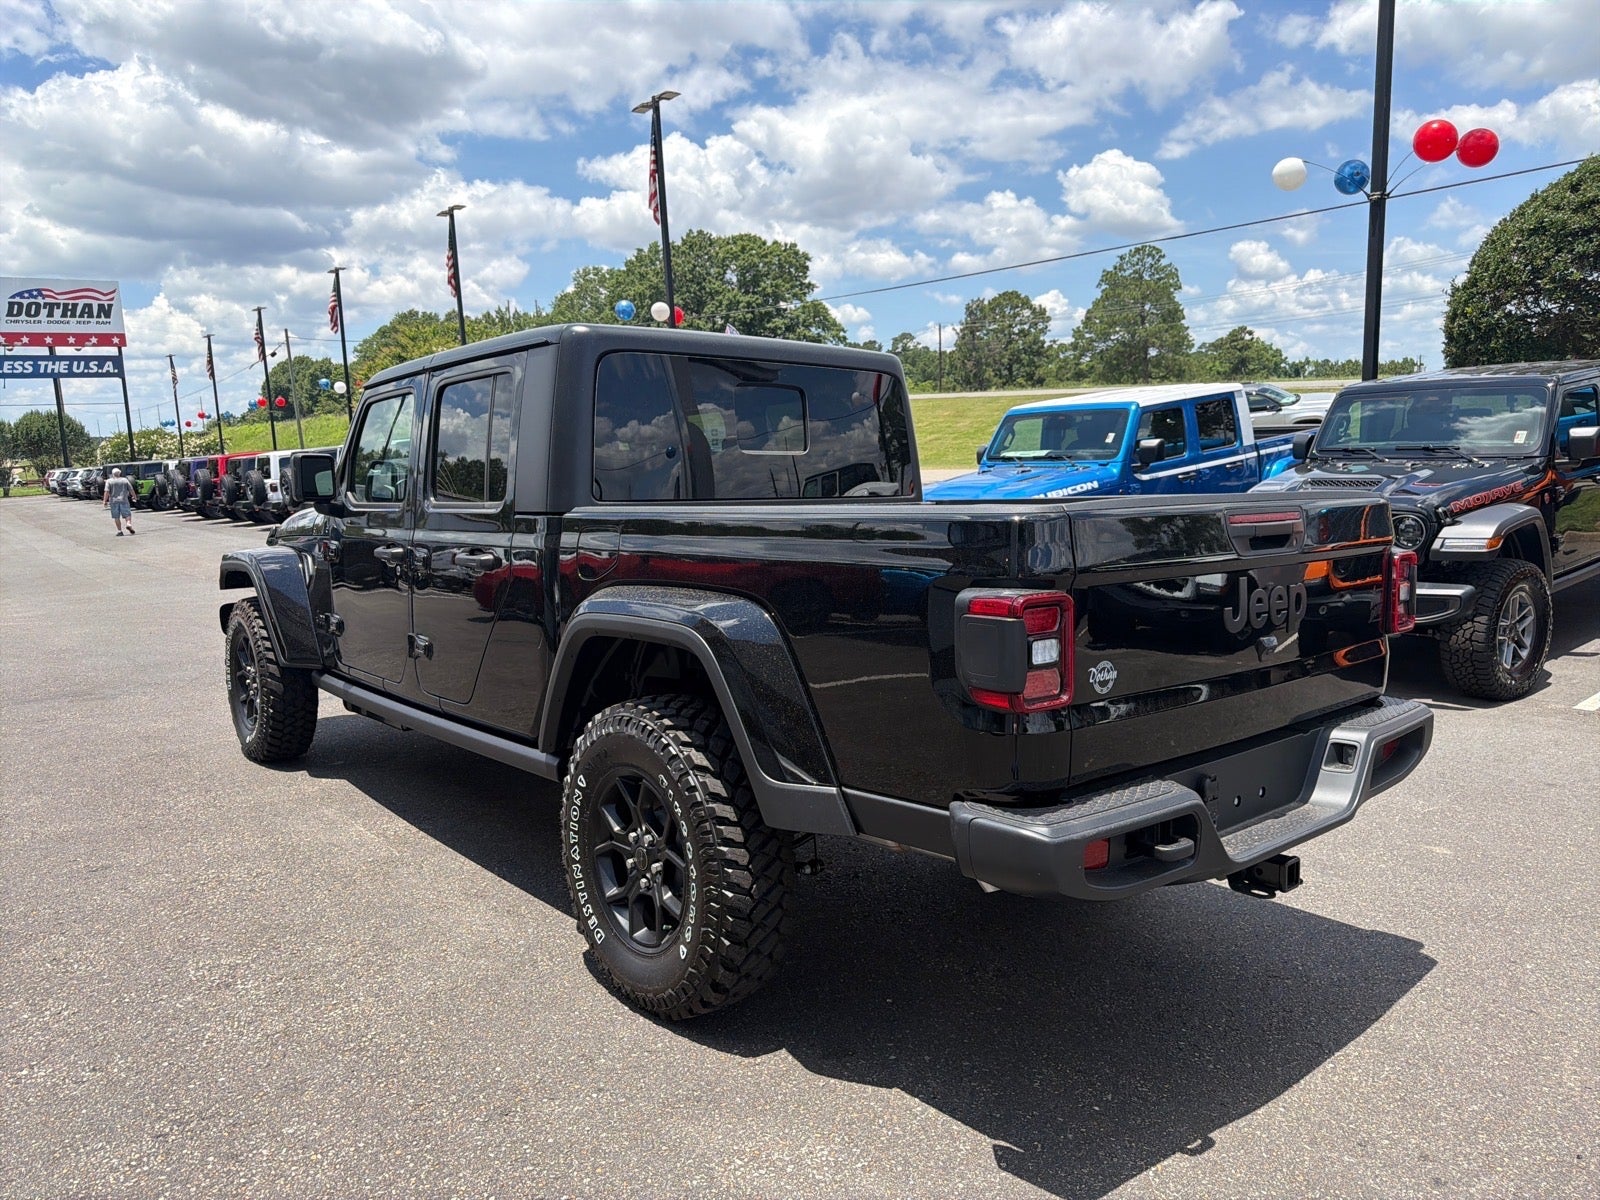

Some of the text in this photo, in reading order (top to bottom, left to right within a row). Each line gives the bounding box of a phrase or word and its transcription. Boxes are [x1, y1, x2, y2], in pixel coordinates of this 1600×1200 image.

[5, 301, 113, 319] DOTHAN
[37, 361, 69, 373] THE
[72, 361, 118, 373] U.S.A.
[1451, 480, 1524, 512] MOJAVE
[1223, 576, 1308, 634] Jeep
[569, 790, 605, 944] DESTINATION
